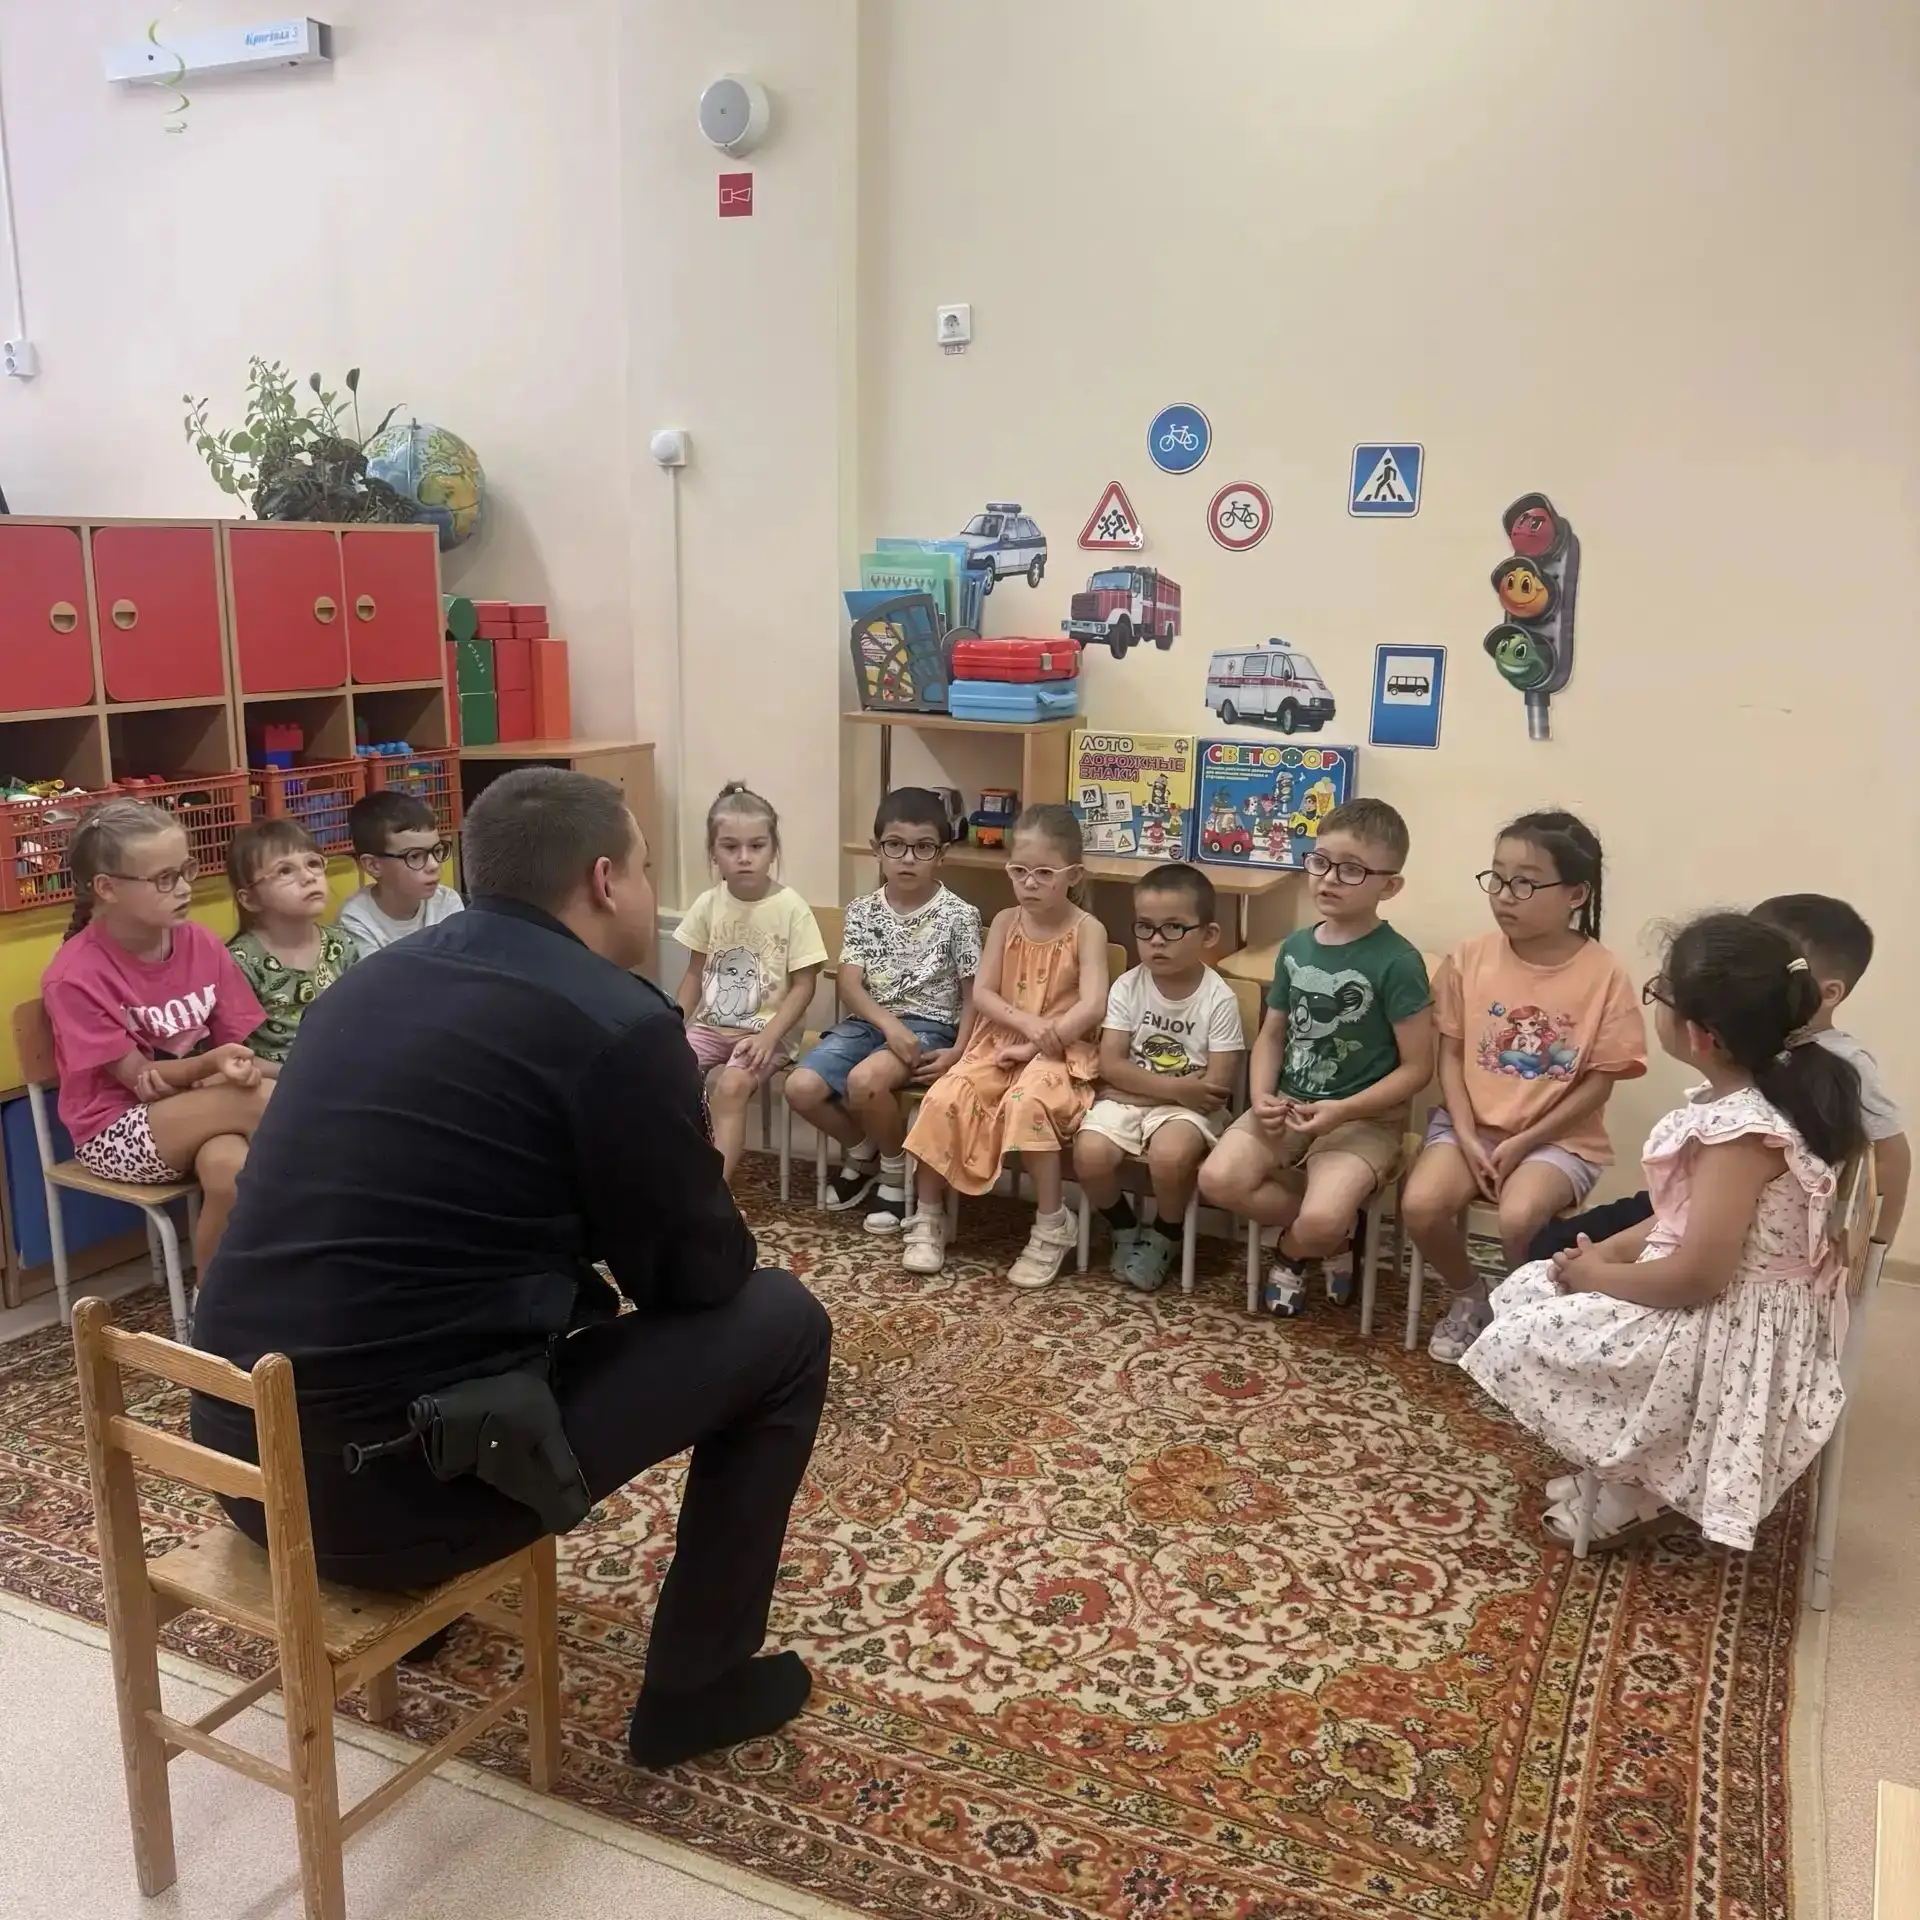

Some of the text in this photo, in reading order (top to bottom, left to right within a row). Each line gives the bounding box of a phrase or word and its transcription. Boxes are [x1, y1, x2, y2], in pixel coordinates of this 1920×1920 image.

[1080, 735, 1133, 752] ЛОТО
[1079, 753, 1186, 772] ДОРОЖНЫЕ
[1208, 744, 1340, 770] СВЕТОФОР
[1079, 765, 1140, 783] ЗНАКИ
[1142, 1010, 1196, 1035] ENJOY
